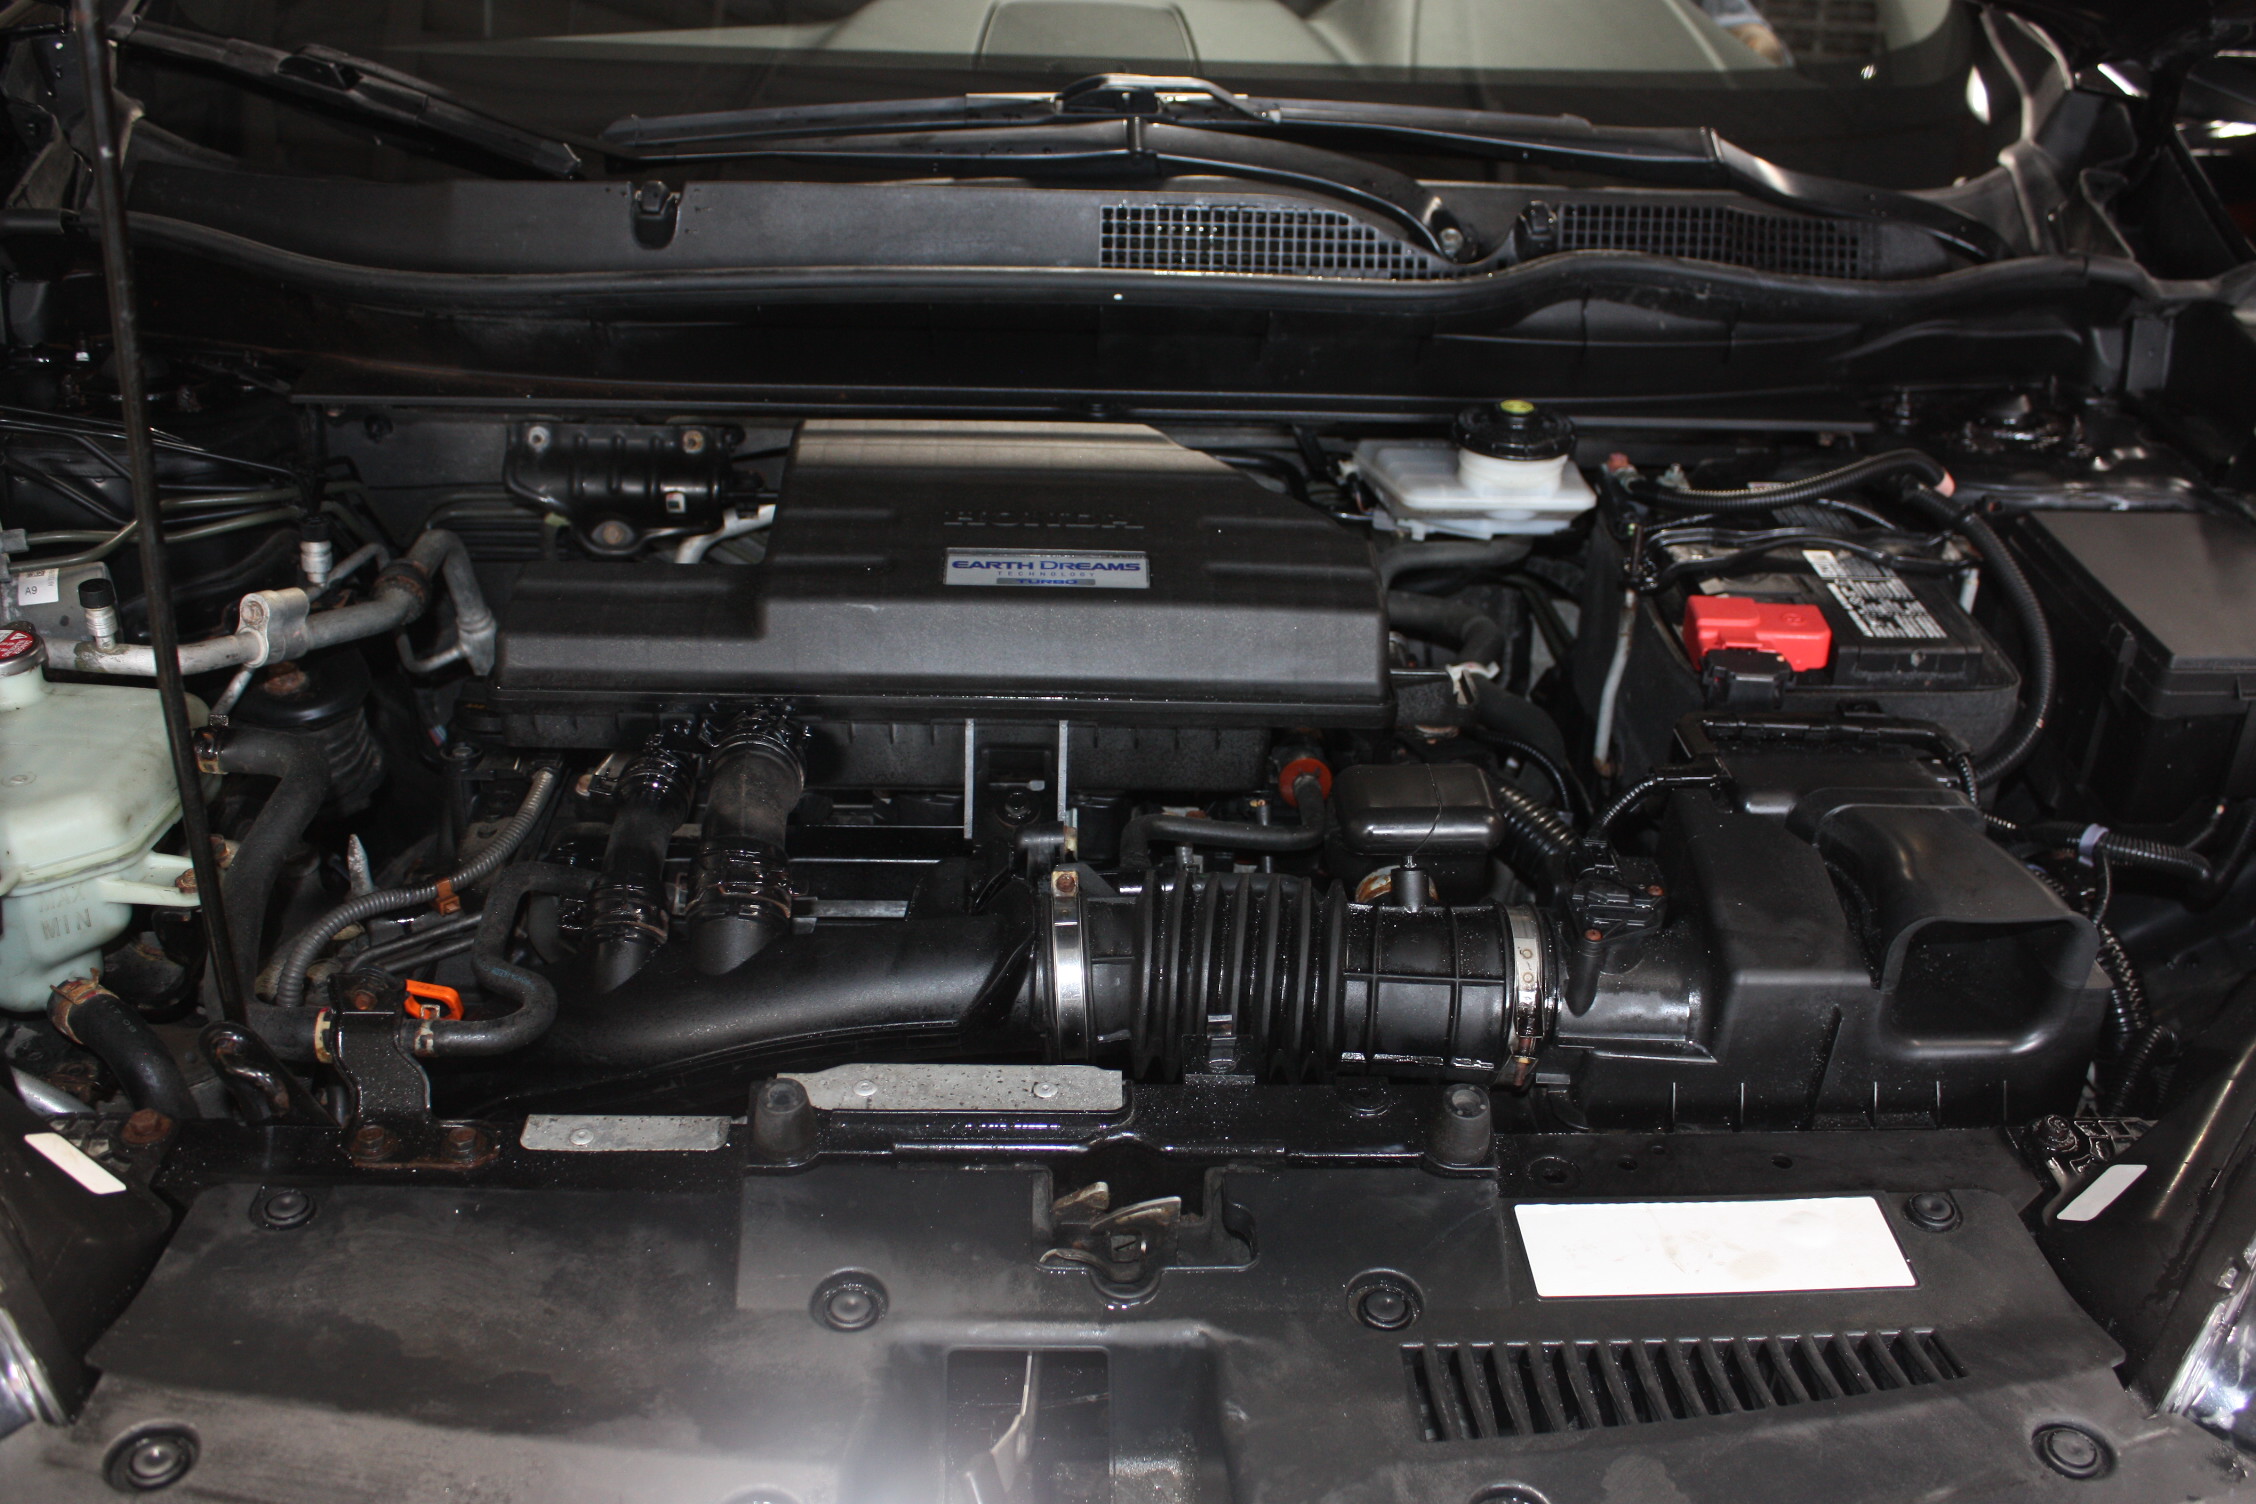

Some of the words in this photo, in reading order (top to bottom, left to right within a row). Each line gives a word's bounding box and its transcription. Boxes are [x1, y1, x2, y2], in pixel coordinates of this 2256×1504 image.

[952, 560, 1034, 570] EARTH
[1040, 561, 1141, 571] DREAMS
[25, 586, 38, 596] A9
[41, 908, 92, 939] MIN
